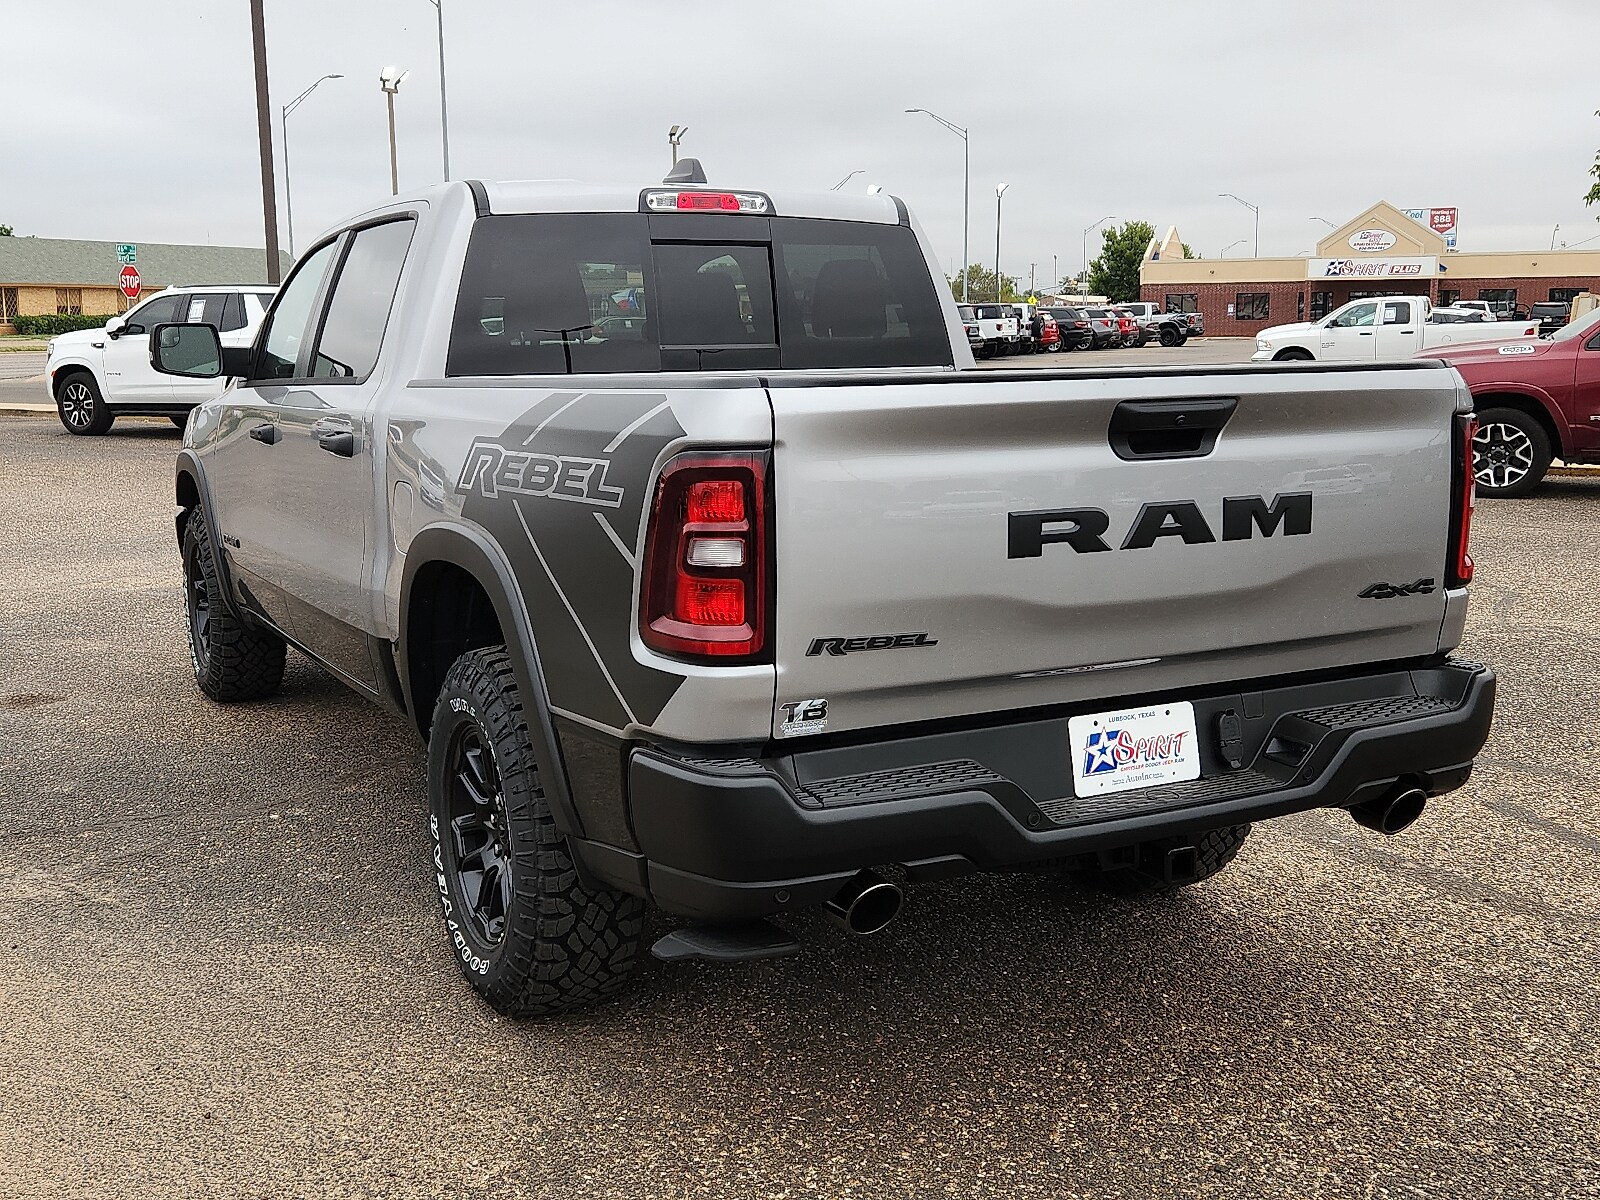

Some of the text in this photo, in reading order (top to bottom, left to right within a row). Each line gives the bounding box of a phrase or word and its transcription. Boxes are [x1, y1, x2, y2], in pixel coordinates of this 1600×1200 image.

[1433, 215, 1451, 223] $88
[1392, 265, 1420, 274] PLUS
[121, 275, 139, 288] STOP
[458, 442, 625, 509] REBEL
[1008, 491, 1313, 560] RAM
[804, 632, 939, 657] REBEL
[1138, 710, 1156, 719] TEXAS
[1115, 730, 1189, 765] SPIRIT
